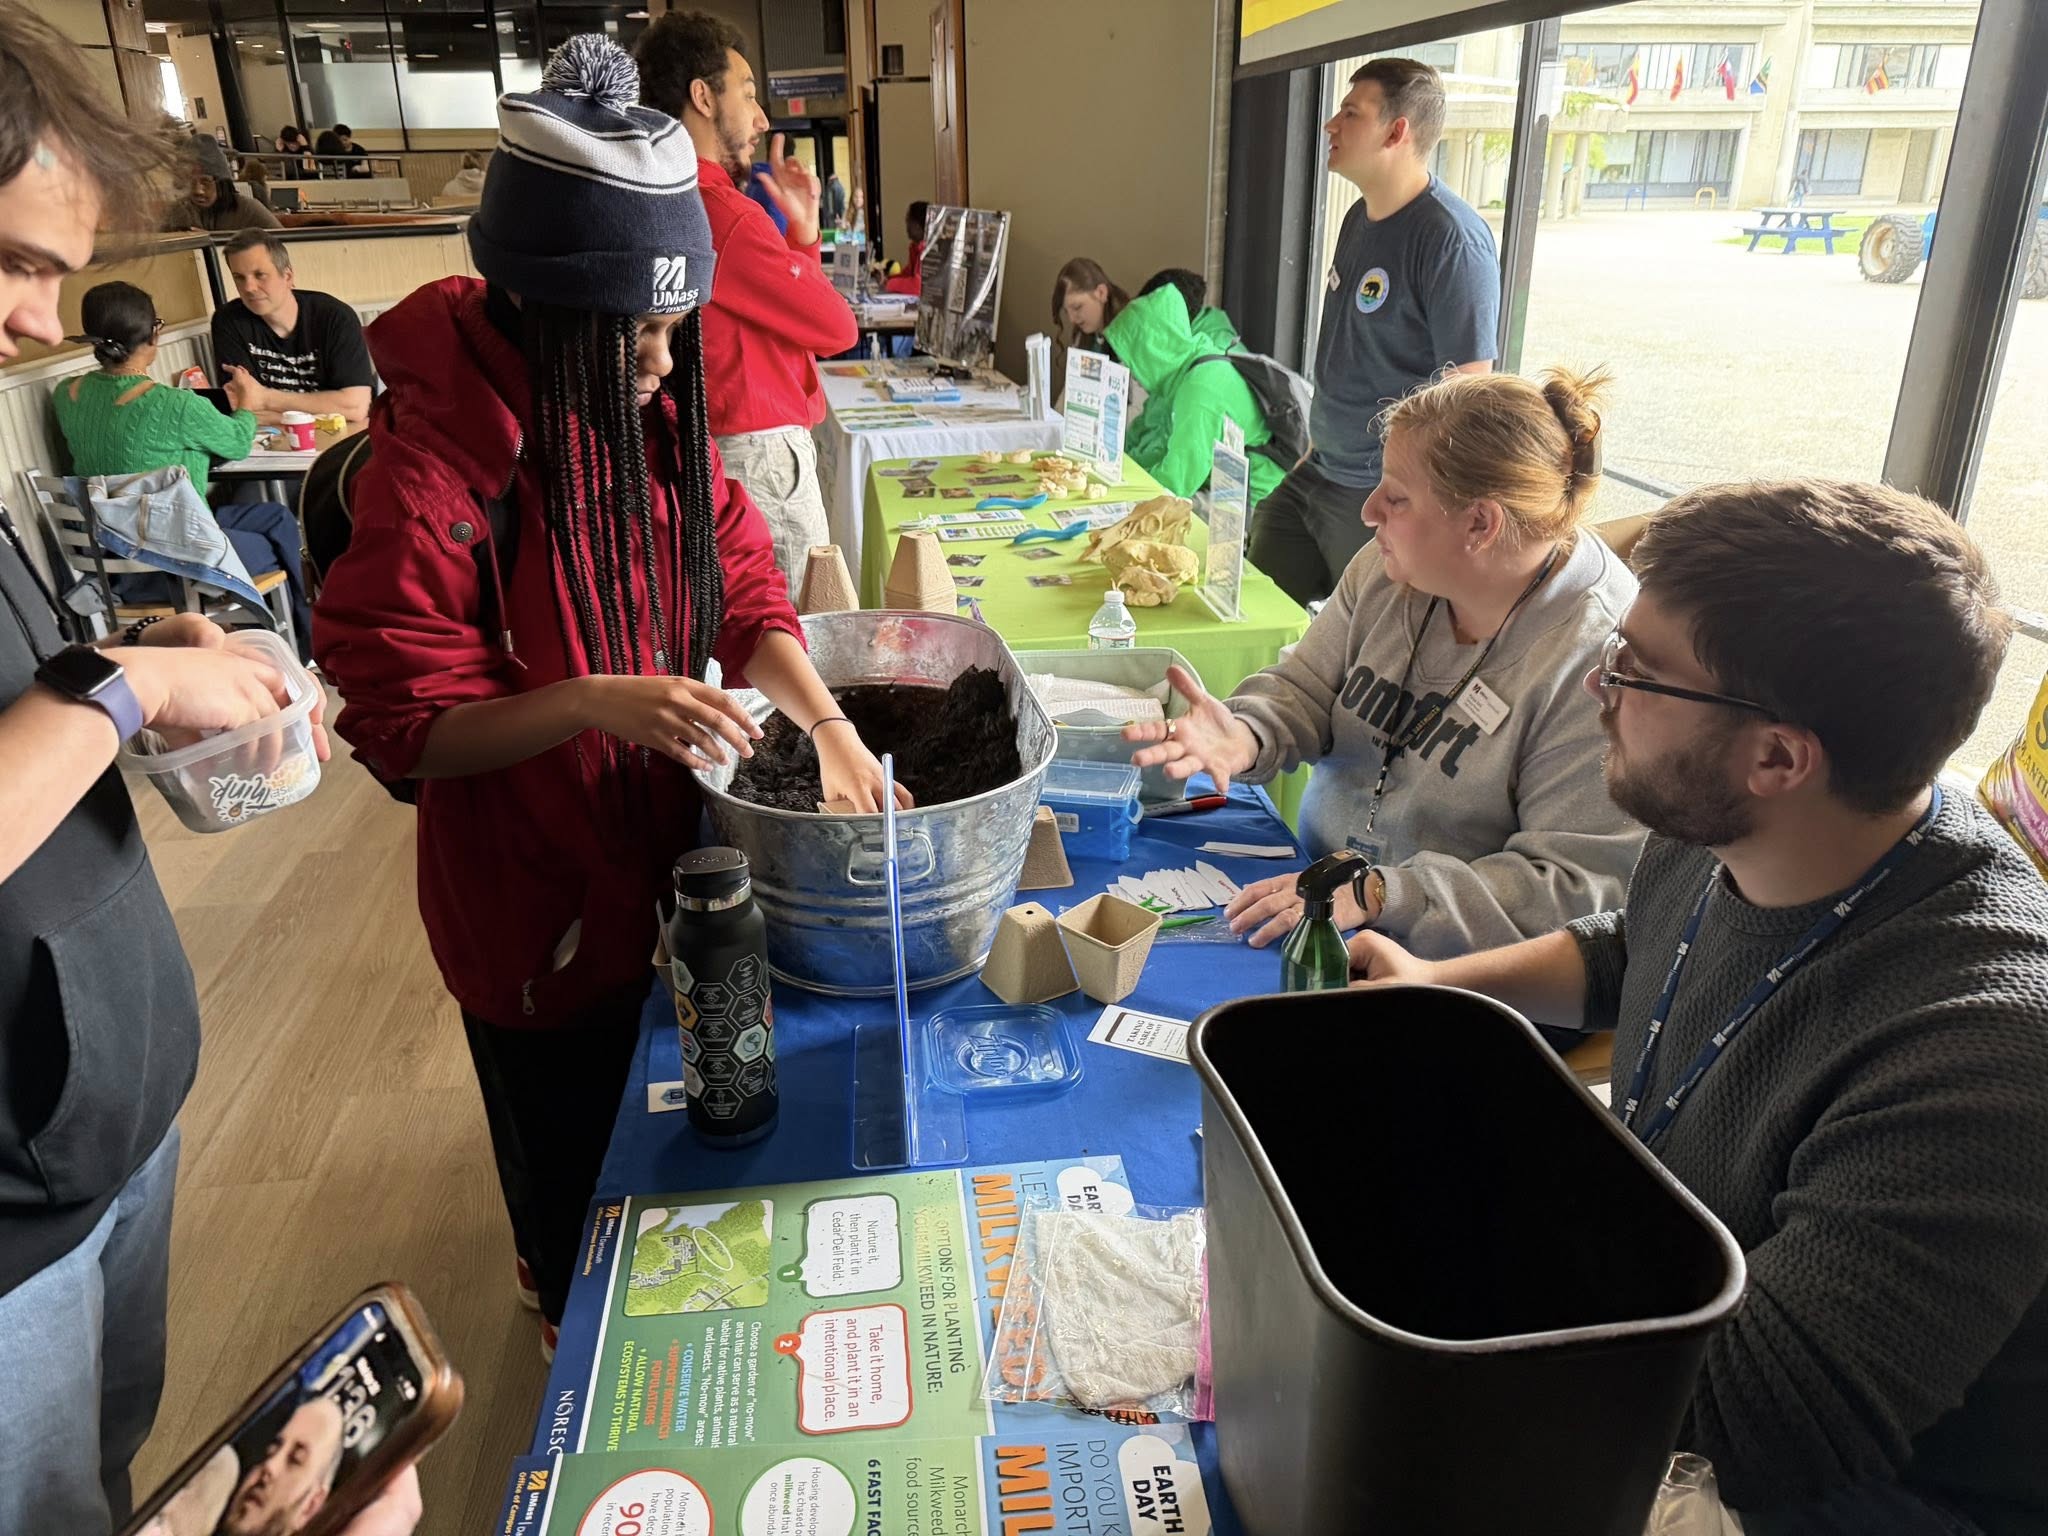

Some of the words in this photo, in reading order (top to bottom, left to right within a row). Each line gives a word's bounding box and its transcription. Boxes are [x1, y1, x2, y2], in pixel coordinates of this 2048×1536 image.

[653, 288, 699, 306] UMass
[1341, 665, 1482, 779] omfort
[832, 1211, 845, 1236] Cedar
[849, 1213, 861, 1232] then
[866, 1220, 880, 1253] Nurture
[832, 1238, 845, 1255] Dell
[848, 1234, 861, 1256] plant
[866, 1254, 880, 1265] it,
[935, 1220, 954, 1273] OPTIONS
[832, 1257, 845, 1282] Field.
[850, 1266, 860, 1275] in
[916, 1244, 936, 1312] MILKWEED
[941, 1275, 957, 1300] FOR
[705, 1326, 716, 1344] and
[719, 1318, 733, 1346] habitat
[735, 1321, 745, 1339] area
[749, 1321, 762, 1350] Choose
[846, 1318, 861, 1340] and
[921, 1313, 938, 1330] IN
[734, 1339, 745, 1355] that
[779, 1340, 792, 1348] 2
[824, 1318, 839, 1382] intentional
[869, 1324, 884, 1352] Take
[943, 1301, 966, 1374] PLANTING
[665, 1345, 681, 1389] SUPPORT
[701, 1344, 714, 1373] insects.
[718, 1346, 729, 1359] for
[732, 1355, 742, 1373] can
[843, 1342, 860, 1373] plant
[870, 1354, 884, 1364] it
[923, 1331, 943, 1394] NATURE:
[615, 1340, 635, 1400] ECOSYSTEMS
[634, 1355, 648, 1387] ALLOW
[679, 1349, 695, 1397] CONSERVE
[715, 1359, 728, 1385] native
[747, 1358, 760, 1387] garden
[847, 1375, 861, 1385] it
[643, 1360, 663, 1426] POPULATIONS
[730, 1373, 741, 1397] serve
[747, 1387, 756, 1397] or
[848, 1387, 861, 1399] in
[867, 1366, 885, 1405] home,
[612, 1401, 625, 1415] TO
[626, 1387, 643, 1434] NATURAL
[658, 1389, 674, 1440] MONARCH
[675, 1397, 689, 1432] WATER
[712, 1385, 726, 1415] plants,
[730, 1397, 740, 1408] as
[821, 1385, 839, 1423] place.
[847, 1401, 859, 1417] an
[606, 1415, 623, 1452] THRIVE
[694, 1419, 706, 1446] areas:
[727, 1415, 739, 1446] natural
[867, 1459, 878, 1468] 6
[1087, 1440, 1109, 1468] DO
[514, 1471, 527, 1494] Office
[808, 1466, 822, 1501] Housing
[905, 1457, 922, 1488] food
[513, 1494, 521, 1504] of
[769, 1482, 778, 1502] once
[782, 1474, 793, 1515] milkweed
[798, 1481, 808, 1495] has
[867, 1470, 881, 1507] FAST
[929, 1467, 946, 1536] Milkweed
[1055, 1442, 1091, 1536] IMPORT
[1093, 1473, 1119, 1516] YOU
[1132, 1479, 1159, 1522] DAY
[1152, 1465, 1185, 1535] EARTH
[505, 1504, 520, 1534] Campus
[525, 1492, 540, 1521] UMass
[604, 1502, 617, 1511] in
[614, 1502, 645, 1536] 90
[649, 1492, 662, 1517] have
[677, 1491, 691, 1527] Monarch
[795, 1497, 807, 1527] chased
[806, 1501, 819, 1536] develop
[780, 1516, 790, 1534] that
